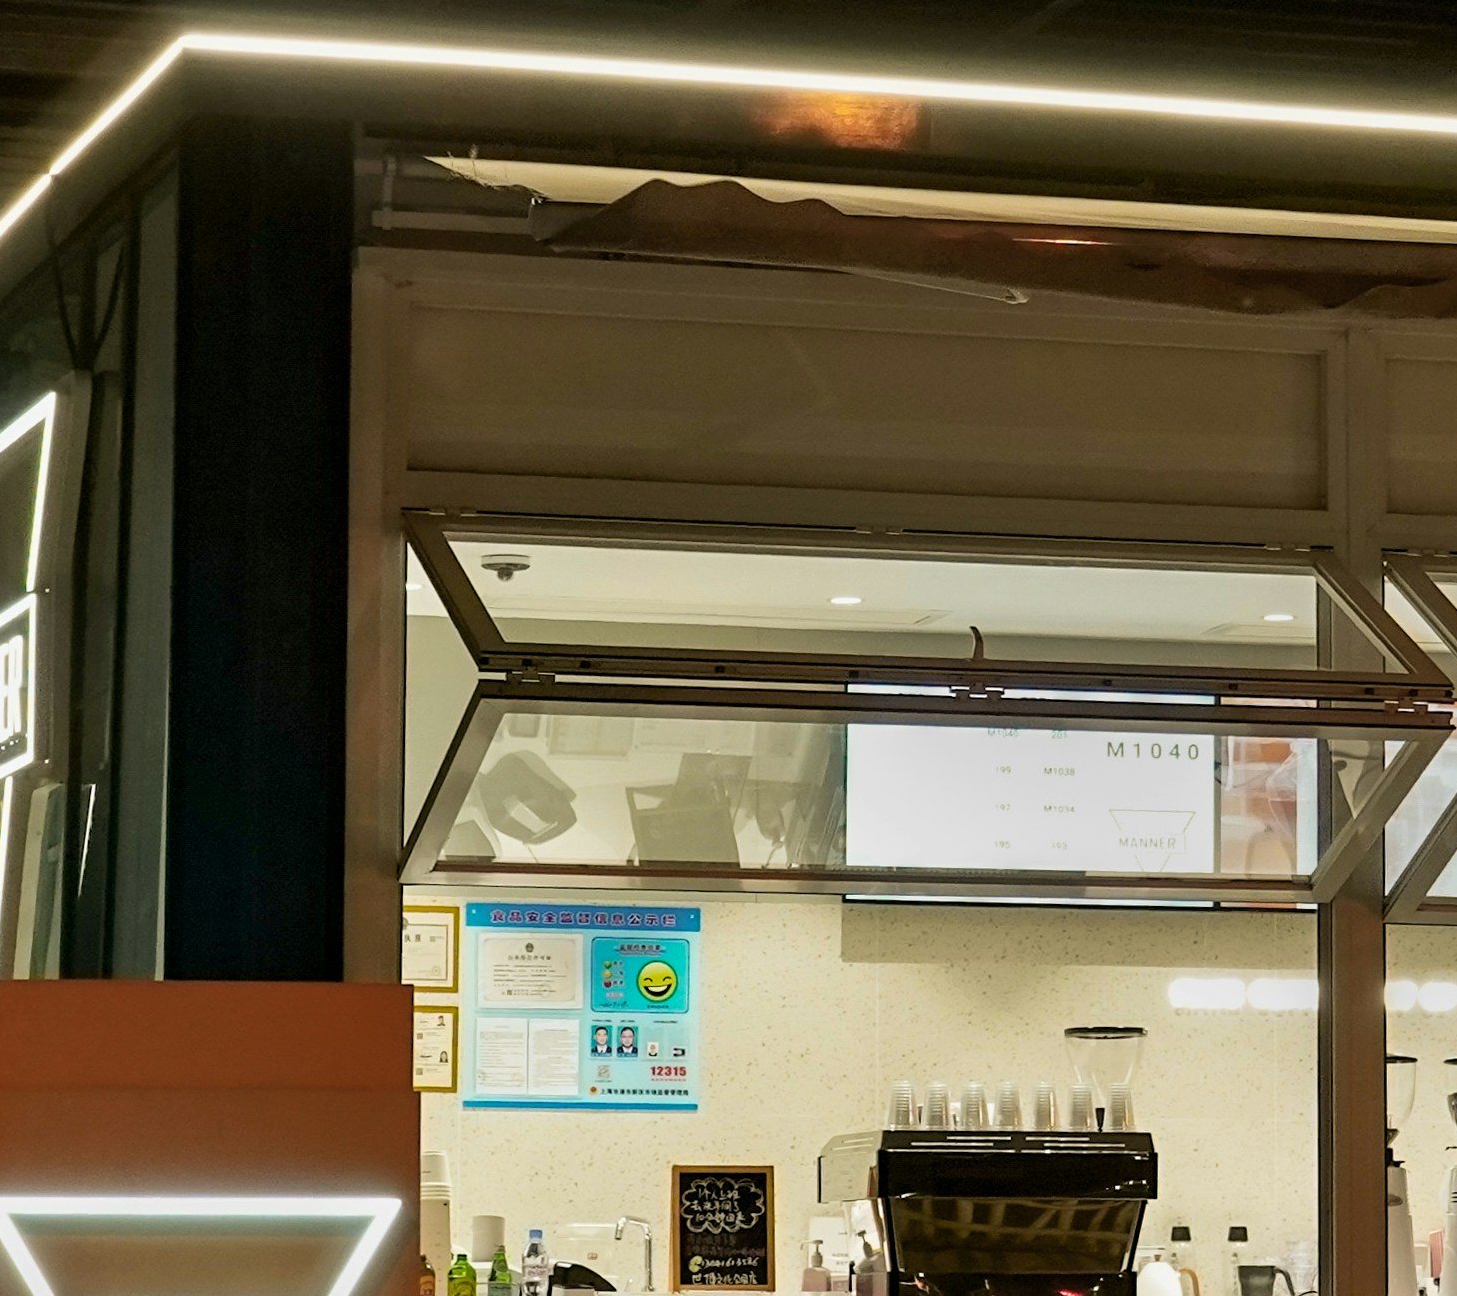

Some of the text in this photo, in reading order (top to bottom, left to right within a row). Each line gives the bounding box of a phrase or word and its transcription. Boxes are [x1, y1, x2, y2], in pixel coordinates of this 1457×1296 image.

[1106, 741, 1200, 760] M1040
[1043, 767, 1076, 776] M1038
[1119, 837, 1177, 850] MANNER
[490, 910, 676, 926] 食品安全监督信息公示栏
[650, 1066, 686, 1076] 12315
